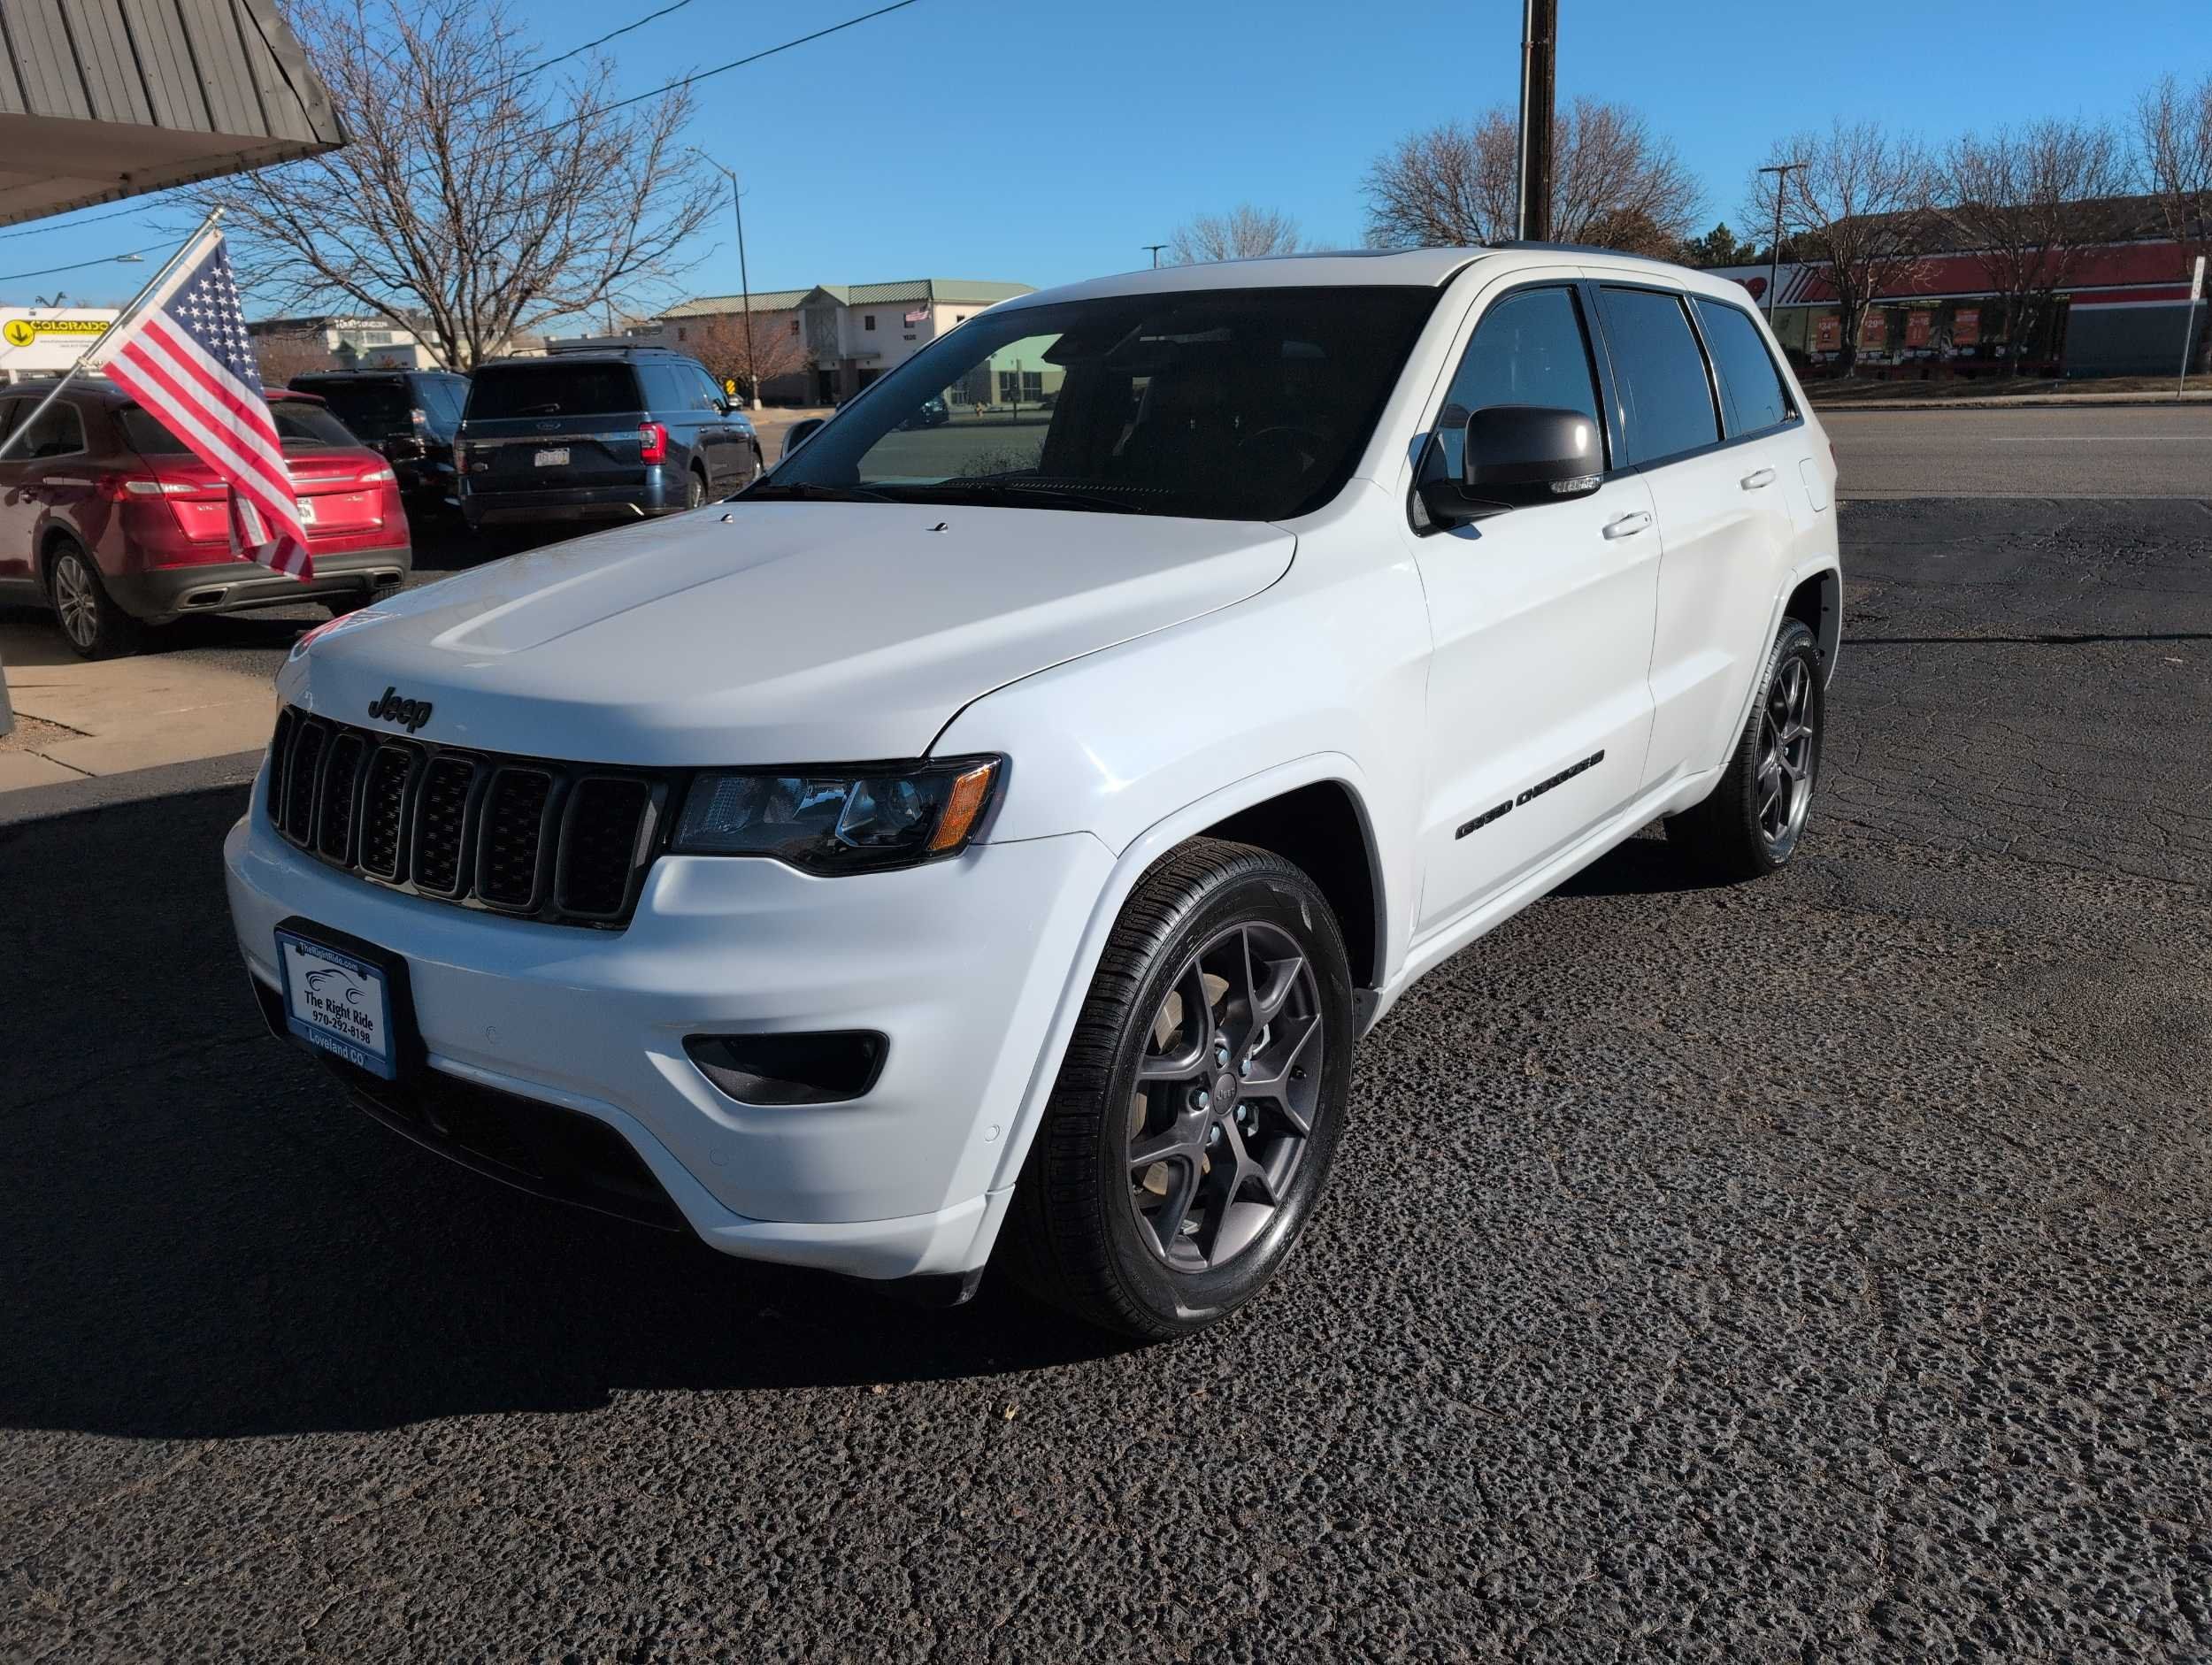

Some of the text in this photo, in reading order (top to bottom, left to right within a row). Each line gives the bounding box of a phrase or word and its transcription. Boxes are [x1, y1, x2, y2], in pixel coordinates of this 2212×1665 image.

[29, 319, 110, 332] COLORADO
[368, 686, 433, 734] Jeep
[299, 941, 358, 971] TheRightRide.com
[304, 990, 374, 1032] The Right Ride
[312, 1009, 371, 1044] 970-292-8198
[310, 1029, 365, 1066] Loveland CO
